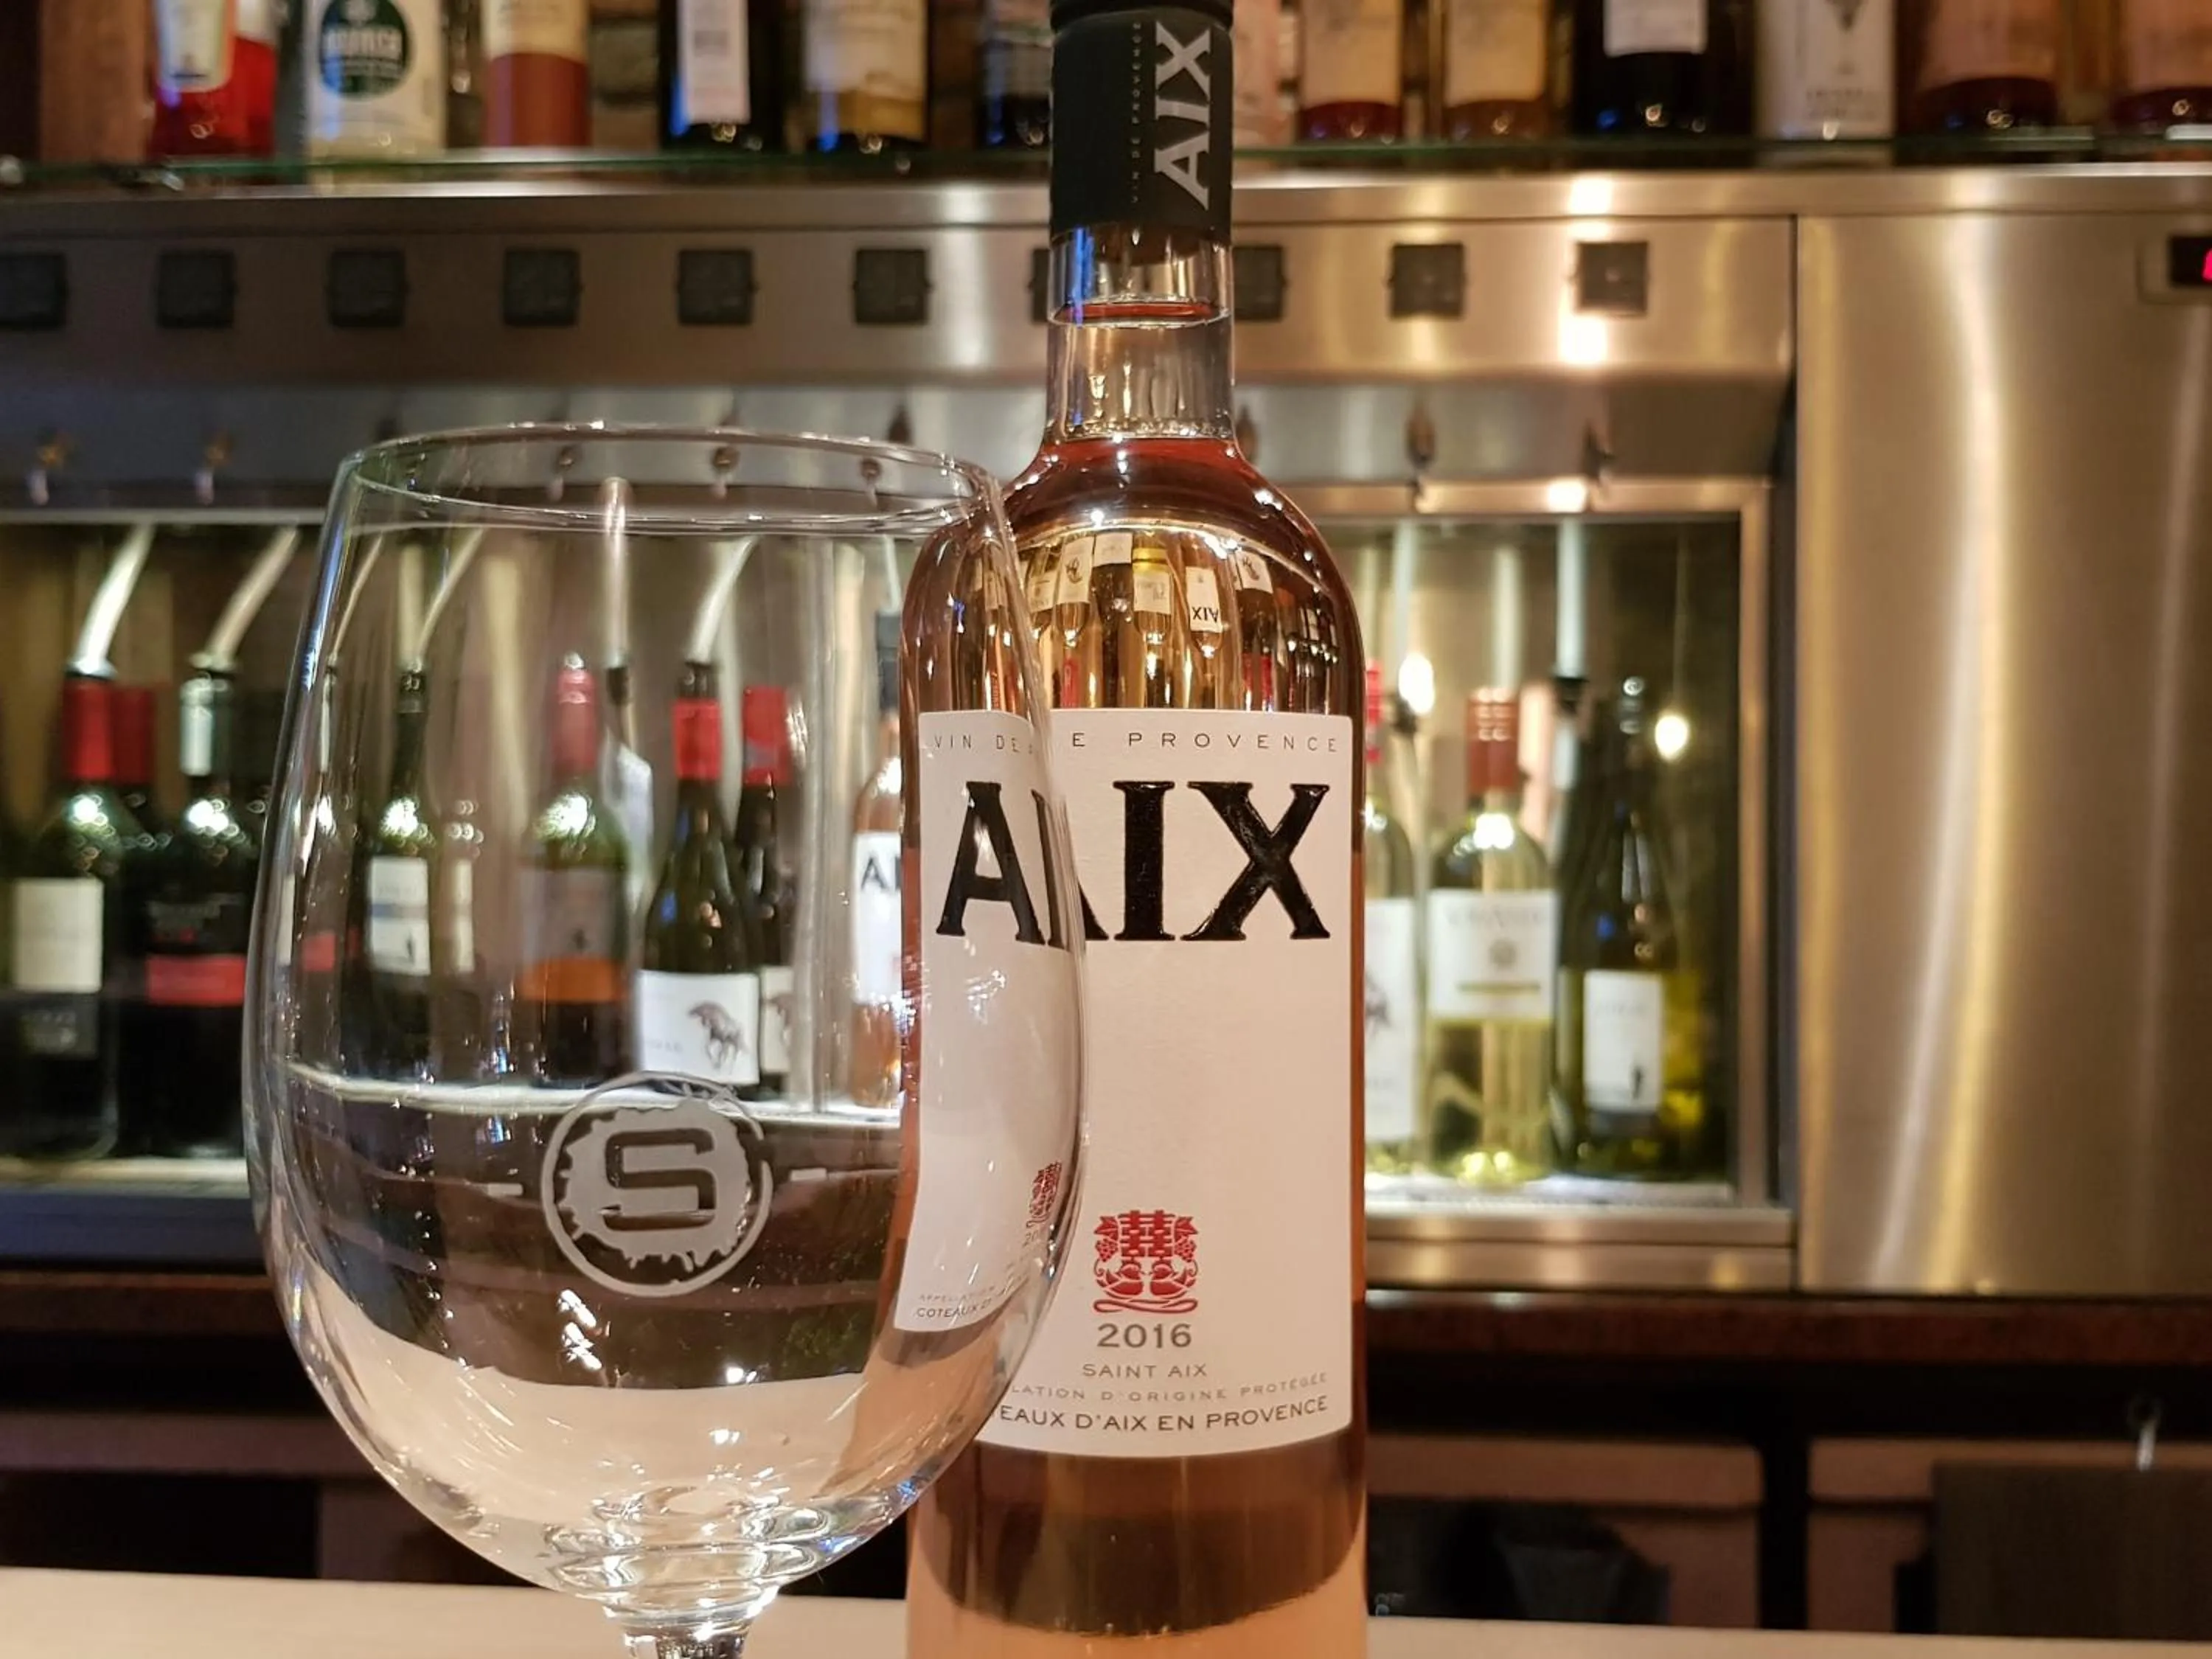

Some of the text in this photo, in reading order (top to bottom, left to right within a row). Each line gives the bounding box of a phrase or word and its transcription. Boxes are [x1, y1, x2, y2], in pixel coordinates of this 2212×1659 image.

[1154, 20, 1210, 211] AIX
[934, 735, 972, 750] VIN
[1128, 732, 1337, 752] PROVENCE
[1096, 1323, 1192, 1349] 2016
[1082, 1364, 1208, 1379] SAINT AIX
[1012, 1385, 1085, 1400] LATION
[1075, 1413, 1148, 1432] D'AIX
[1157, 1414, 1195, 1431] EN
[1206, 1394, 1329, 1430] PROVENCE
